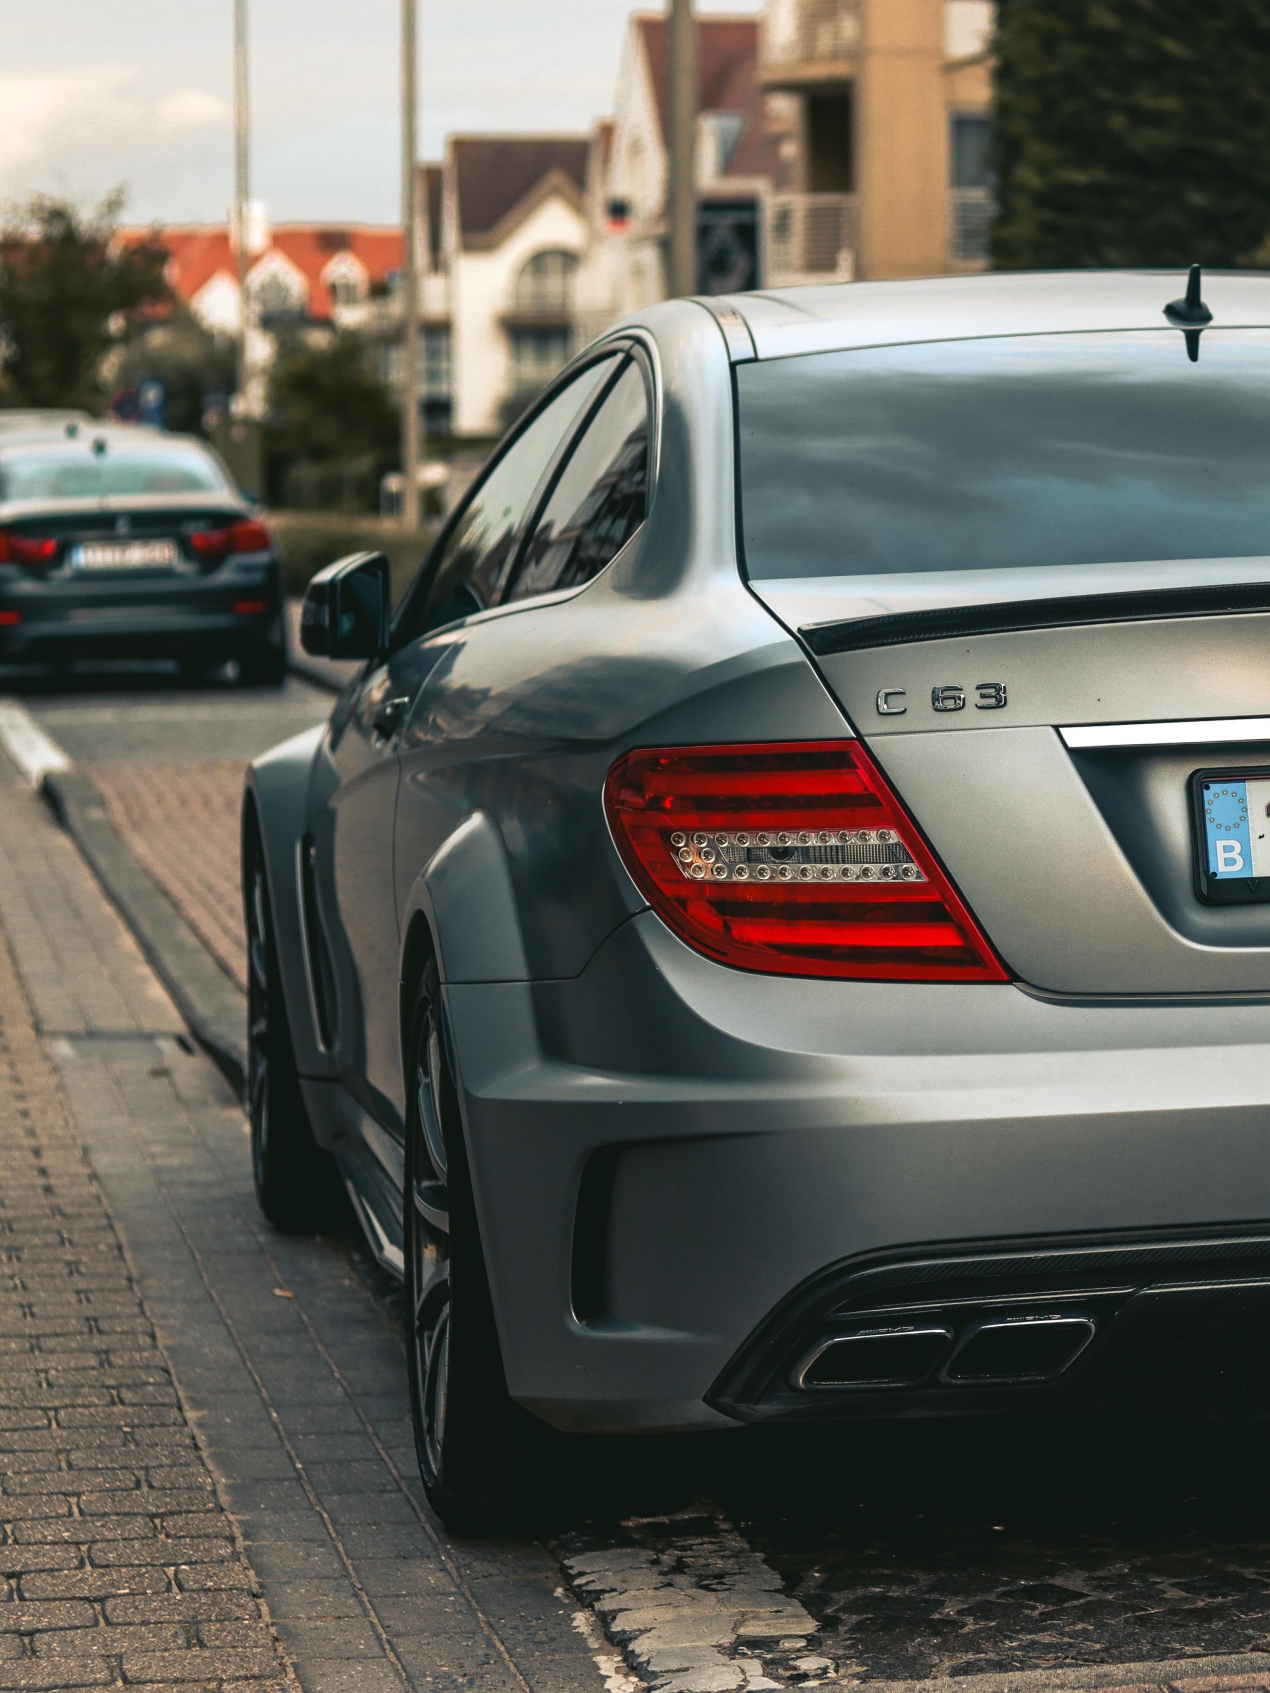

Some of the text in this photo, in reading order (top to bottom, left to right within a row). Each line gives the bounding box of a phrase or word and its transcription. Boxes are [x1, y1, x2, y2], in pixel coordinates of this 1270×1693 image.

[876, 682, 1008, 716] C 63
[1216, 839, 1245, 873] B
